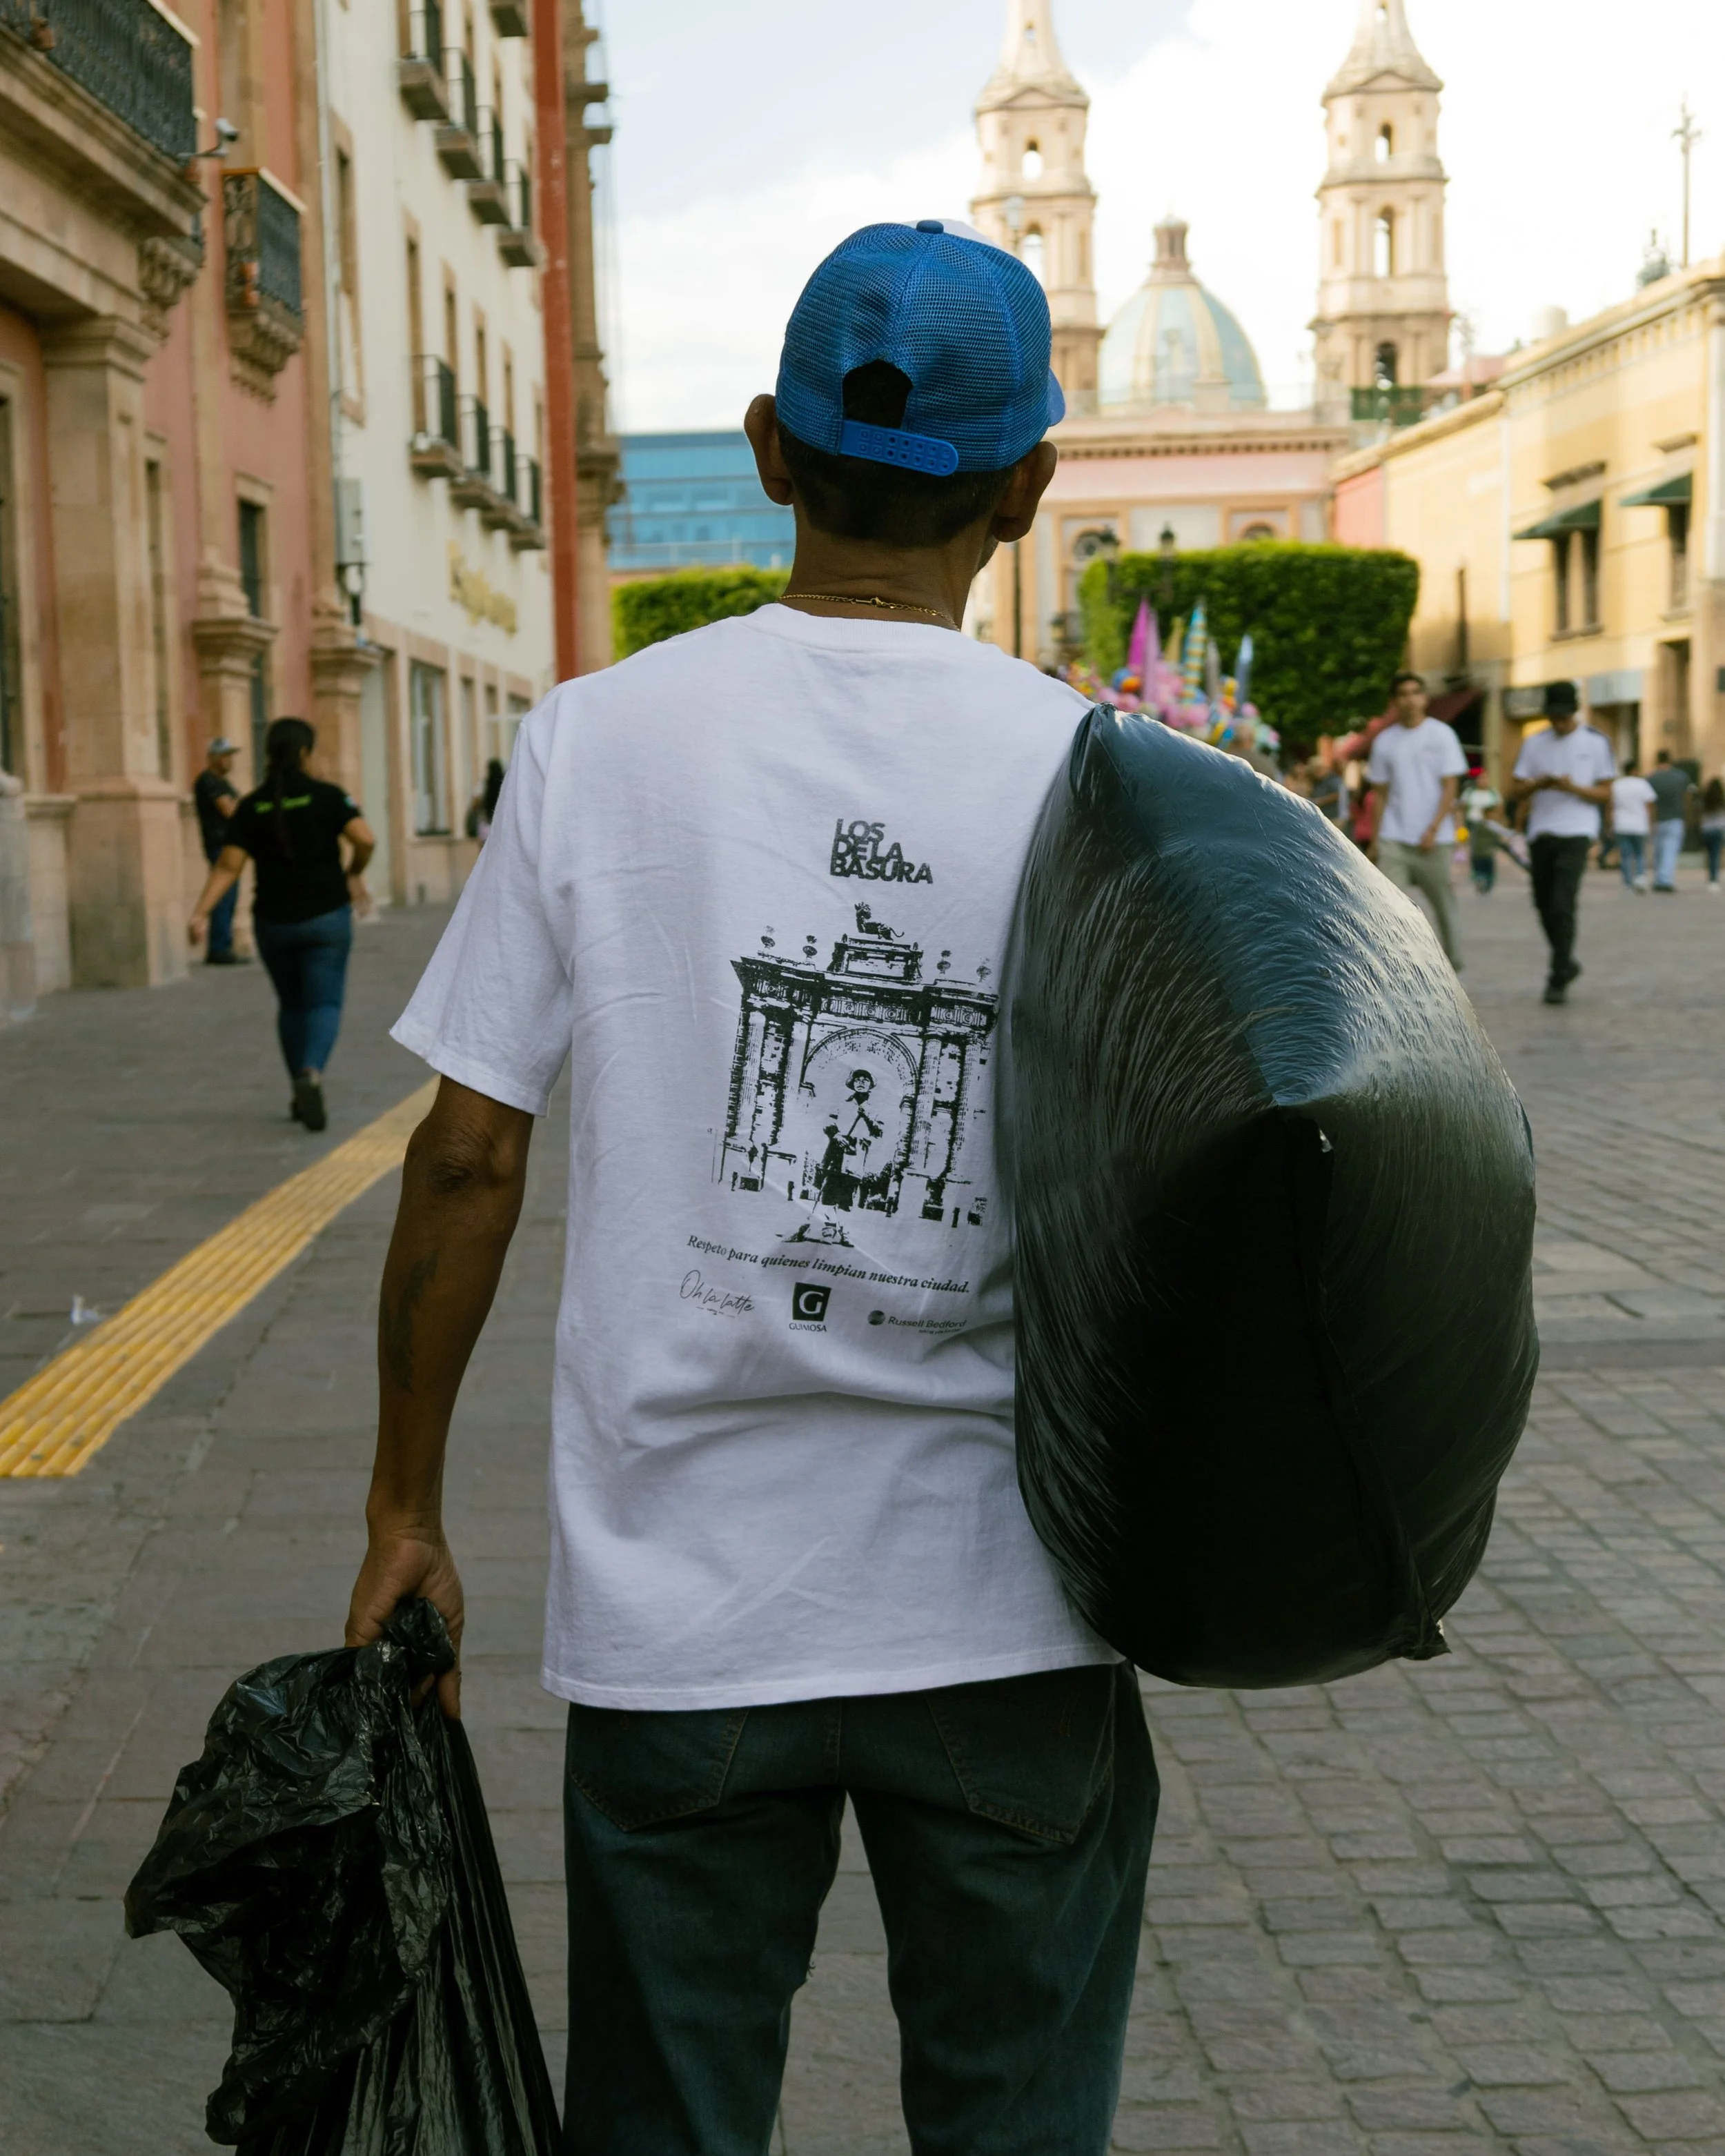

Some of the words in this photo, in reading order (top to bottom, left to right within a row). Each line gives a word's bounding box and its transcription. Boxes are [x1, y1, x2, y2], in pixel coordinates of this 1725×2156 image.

[835, 818, 885, 842] LOS
[830, 857, 934, 884] BASURA
[687, 1235, 727, 1255] Respeto
[727, 1248, 758, 1263] para
[760, 1254, 810, 1268] quienes
[811, 1258, 867, 1278] limpian
[869, 1272, 918, 1287] nuestra
[920, 1278, 969, 1293] ciudad.
[680, 1269, 704, 1299] Oh
[720, 1293, 755, 1315] latte
[798, 1290, 825, 1315] G
[789, 1323, 828, 1332] GUIMOSA
[888, 1316, 925, 1327] Russell
[925, 1319, 967, 1329] Bedford
